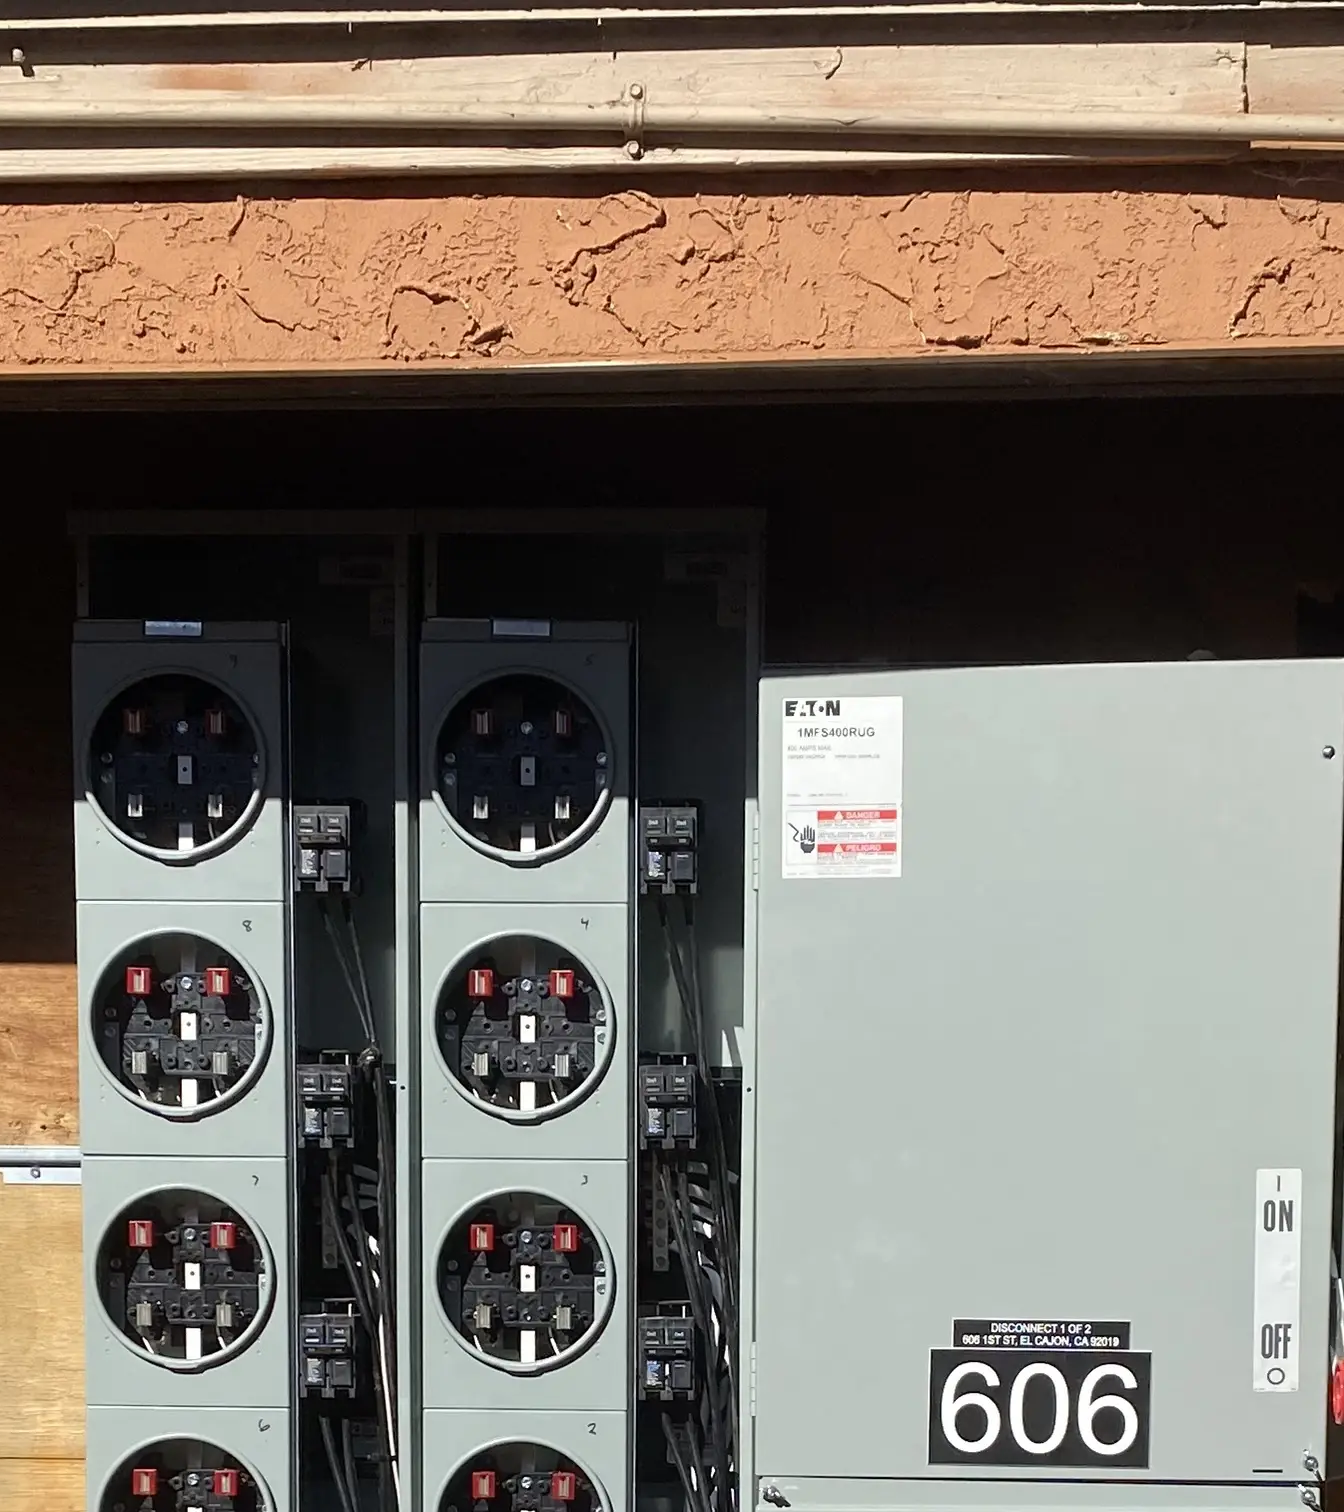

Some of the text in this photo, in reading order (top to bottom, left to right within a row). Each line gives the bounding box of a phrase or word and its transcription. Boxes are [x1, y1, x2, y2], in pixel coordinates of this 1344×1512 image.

[785, 700, 841, 717] EATON
[846, 811, 880, 819] DANGER
[846, 844, 881, 852] PELIGRO
[242, 919, 252, 933] 8
[580, 917, 589, 930] 4
[1263, 1200, 1294, 1232] ON
[991, 1323, 1091, 1334] DISCONNECT 1 OF 2
[962, 1335, 1119, 1347] 606 1ST ST, EL CAJON, CA 92019
[1261, 1323, 1292, 1359] OFF
[941, 1361, 1139, 1456] 606
[258, 1417, 271, 1433] 6
[587, 1422, 597, 1436] 2
